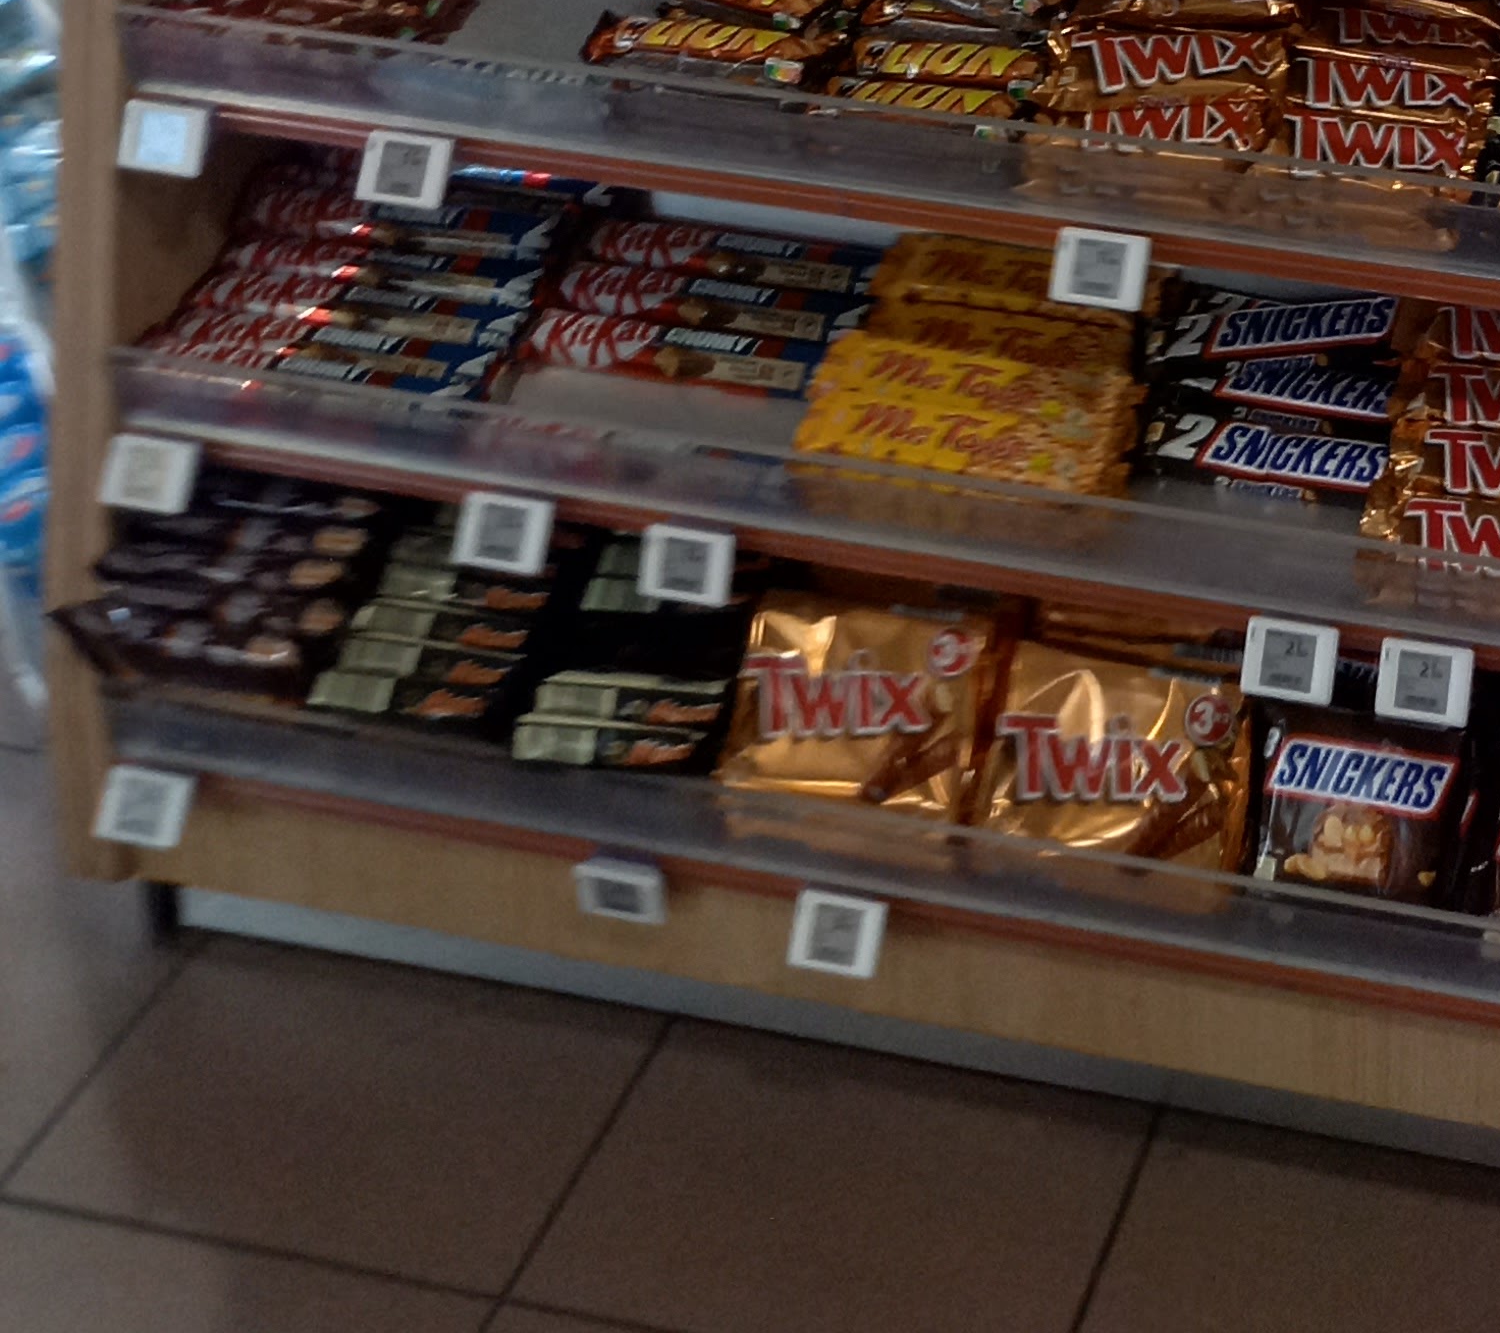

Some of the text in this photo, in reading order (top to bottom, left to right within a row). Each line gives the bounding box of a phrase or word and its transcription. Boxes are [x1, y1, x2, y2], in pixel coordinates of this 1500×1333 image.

[639, 19, 791, 53] LION
[882, 42, 1032, 77] LION
[853, 80, 1008, 115] LION
[531, 312, 660, 367] KitKat
[1222, 297, 1395, 347] SNICKERS
[1233, 359, 1391, 416] SNICKERS
[1157, 413, 1218, 461] 2
[1214, 424, 1391, 484] SNICKERS
[1274, 743, 1447, 810] SNICKERS
